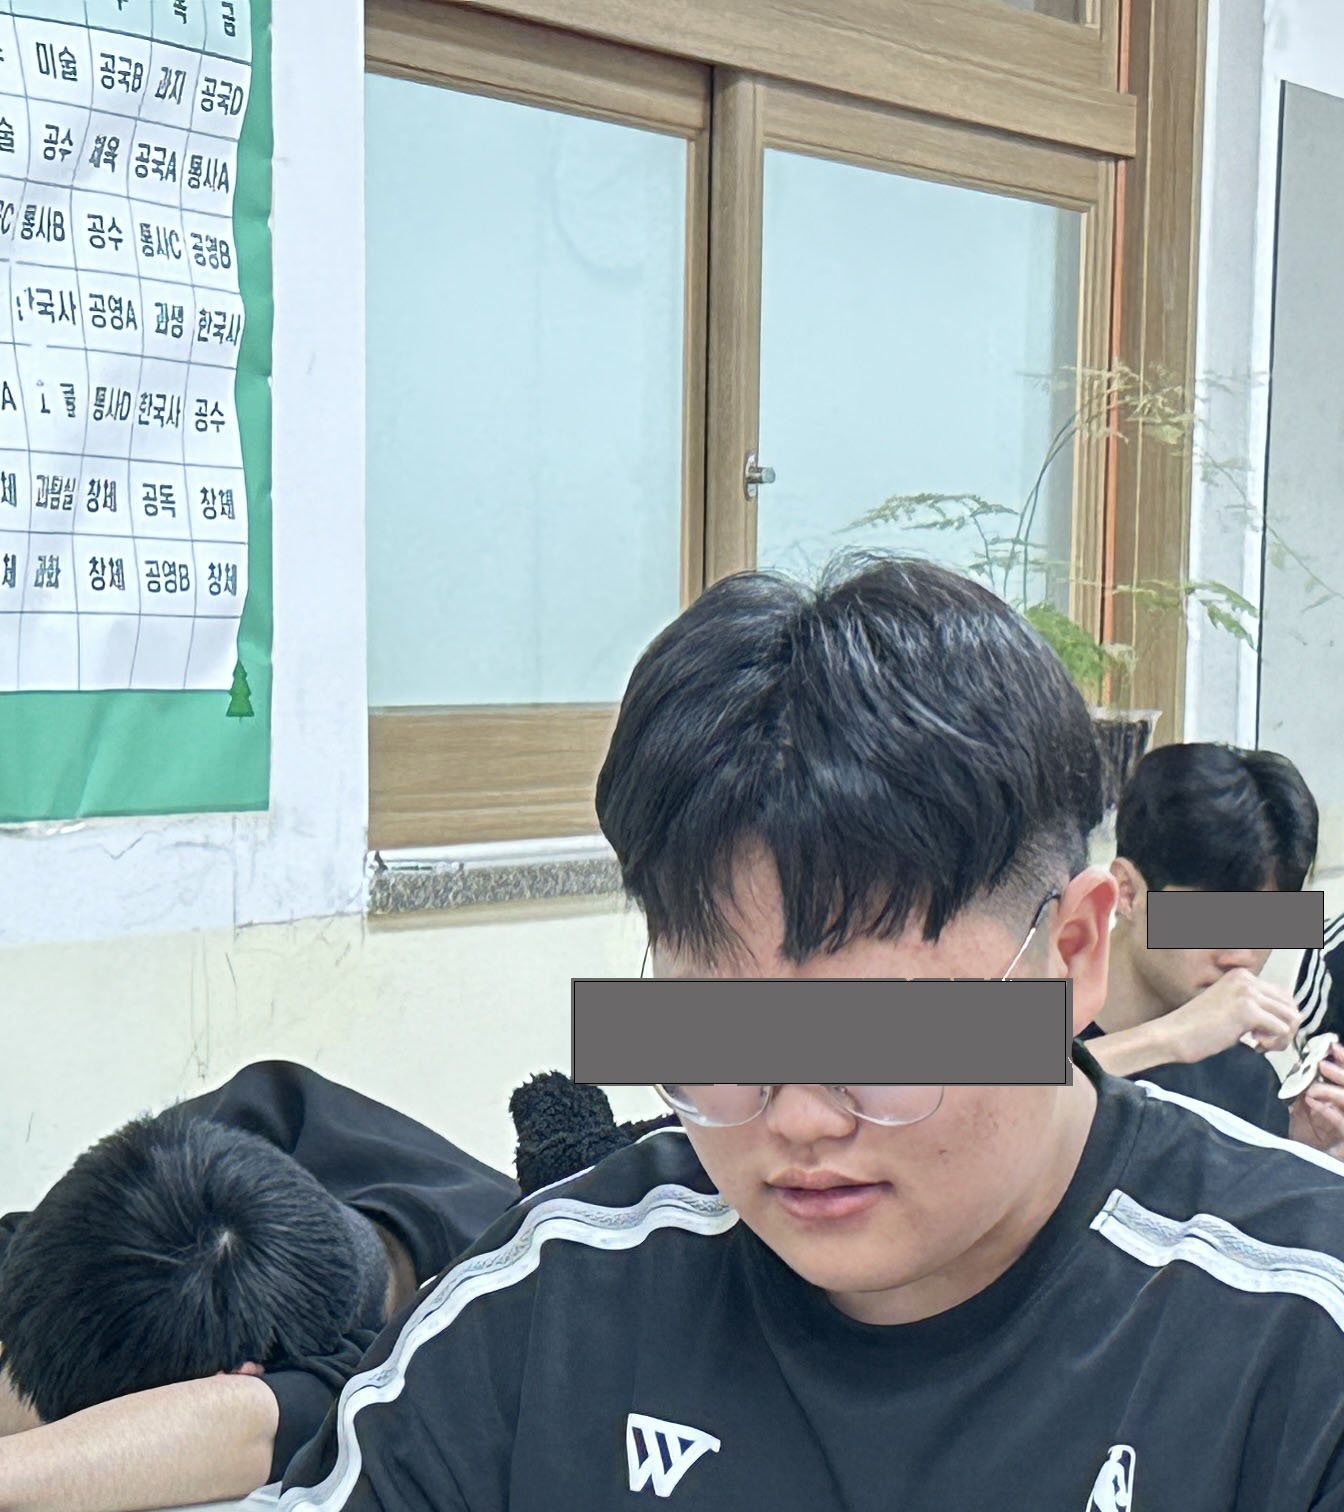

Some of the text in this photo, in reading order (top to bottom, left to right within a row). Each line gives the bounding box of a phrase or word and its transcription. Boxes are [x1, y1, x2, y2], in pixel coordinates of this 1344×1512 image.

[35, 42, 78, 81] 미술
[100, 52, 144, 93] 공국B
[200, 76, 244, 116] 공국D
[43, 123, 74, 162] 공수
[134, 142, 176, 183] 공국A
[87, 213, 124, 251] 공수
[88, 293, 138, 331] 공영A
[197, 307, 242, 346] 한국사
[93, 386, 131, 421] 통사D
[138, 392, 181, 428] 한국사
[195, 399, 225, 432] 공수
[86, 478, 117, 512] 창체
[142, 483, 176, 518] 공독
[200, 486, 235, 520] 창체
[88, 556, 125, 591] 창체
[145, 560, 190, 593] 공영B
[208, 562, 237, 596] 창체
